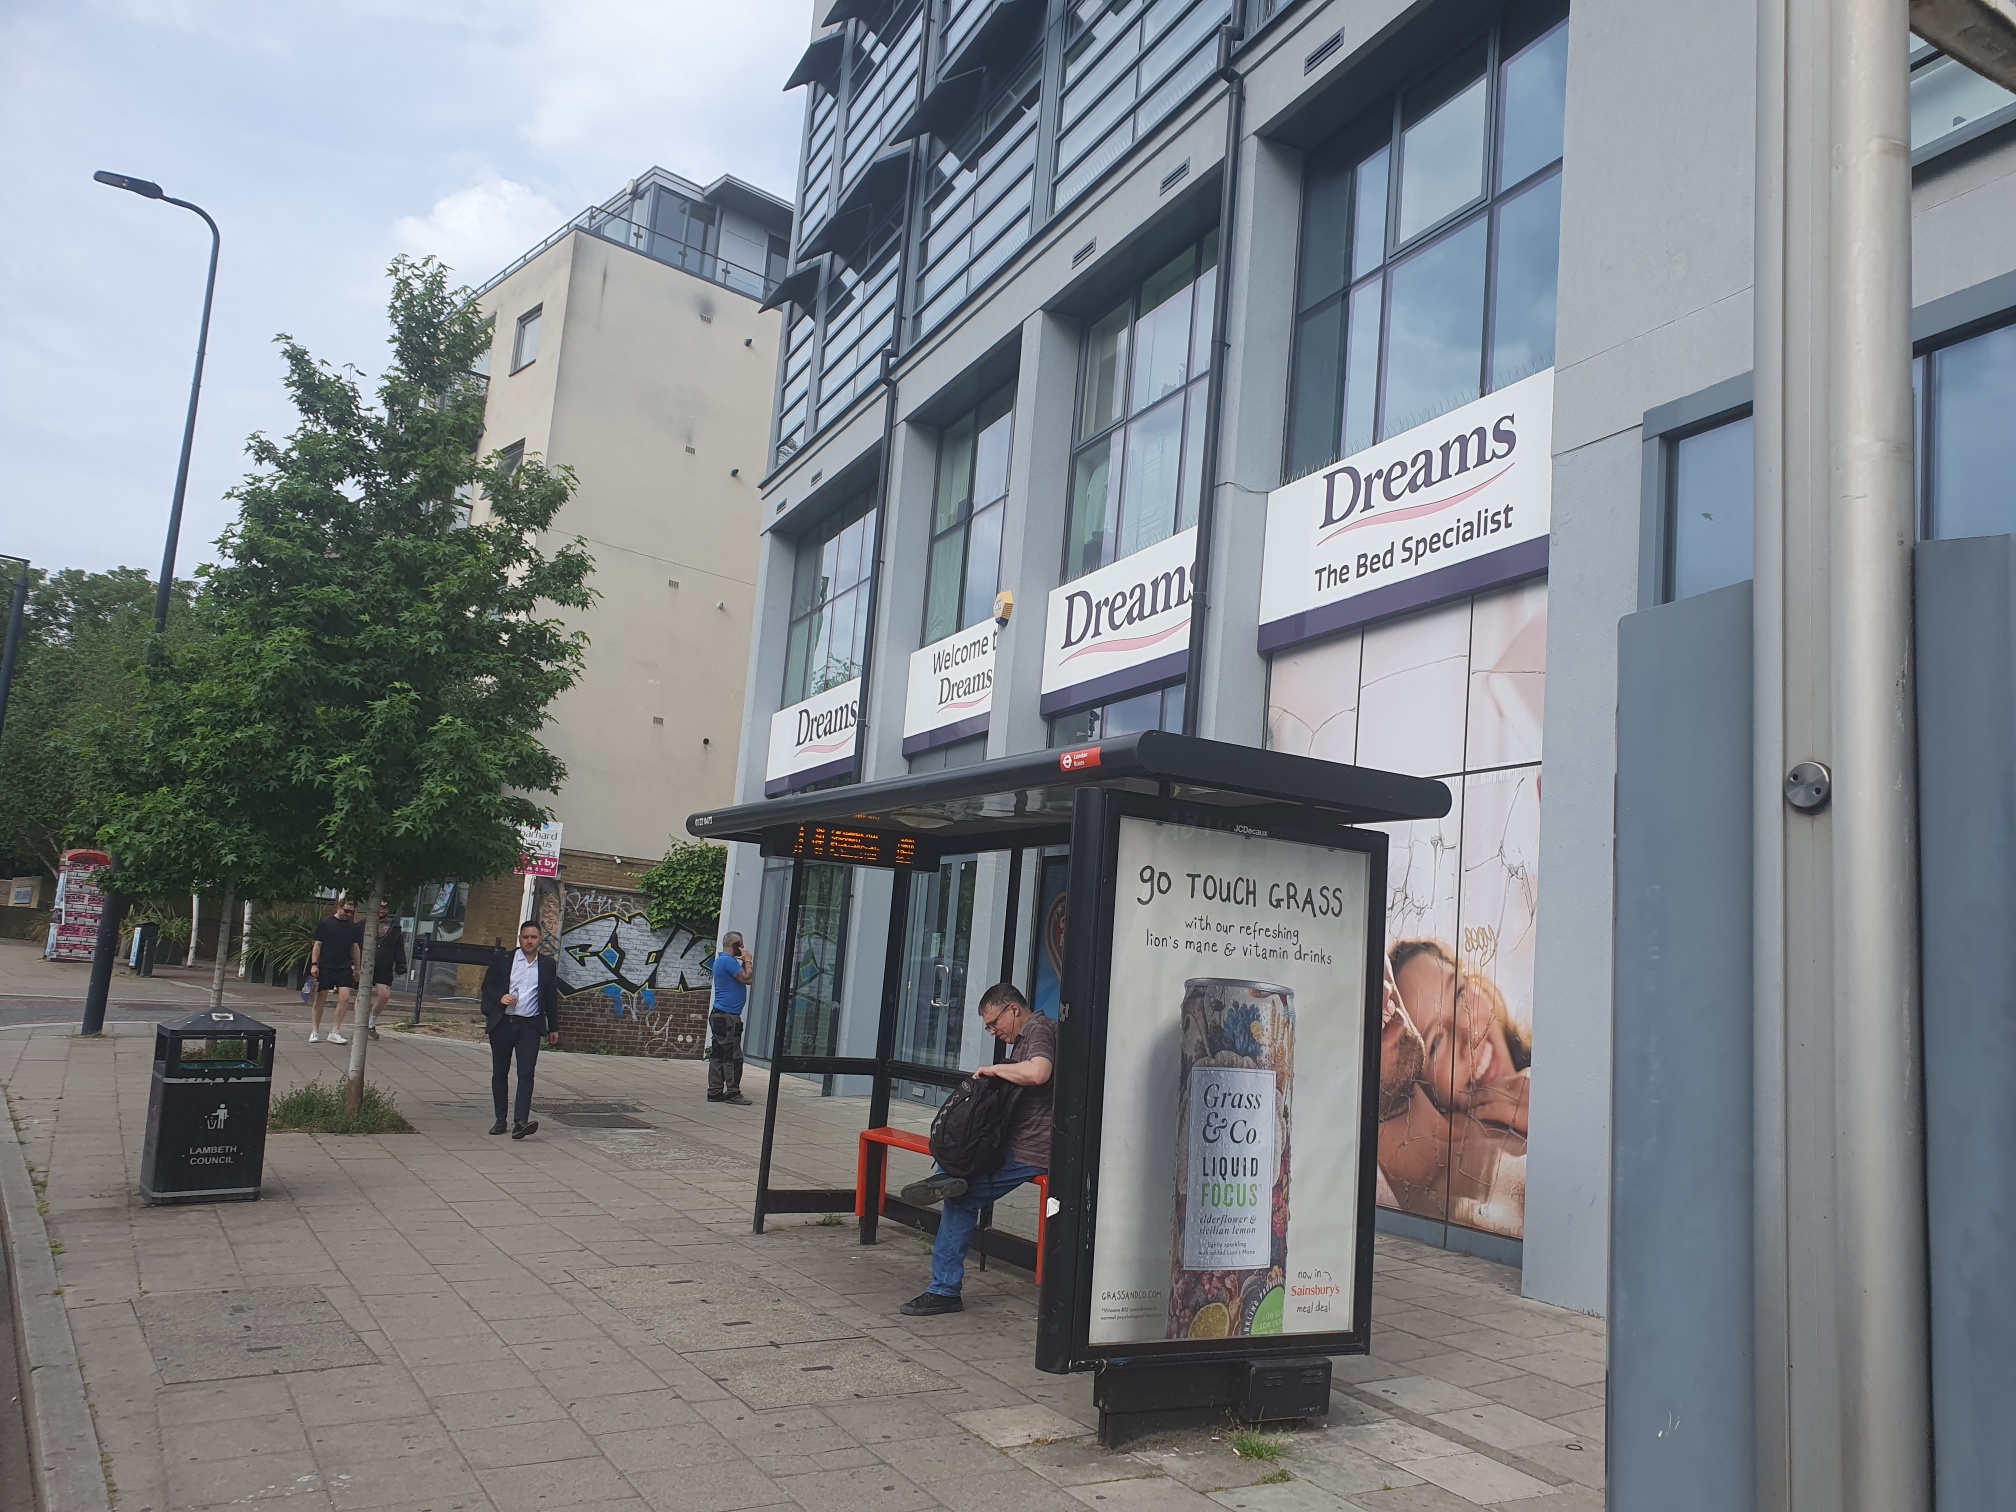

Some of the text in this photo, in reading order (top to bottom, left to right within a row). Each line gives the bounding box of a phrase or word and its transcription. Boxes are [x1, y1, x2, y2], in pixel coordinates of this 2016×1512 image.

[1319, 413, 1517, 530] Dreams
[1314, 503, 1514, 592] The Bed Specialist
[933, 635, 989, 675] Welcome
[937, 668, 993, 706] Dreams
[794, 699, 858, 748] Dreams
[1233, 824, 1269, 837] JCDecaux
[544, 858, 557, 869] by
[1137, 864, 1343, 918] go TOUCH GRASS
[1185, 914, 1300, 946] with our refreshing
[1146, 928, 1333, 966] lion's mane & vitamin drinks
[1203, 1083, 1262, 1110] Grass
[189, 1145, 238, 1155] LAMBETH
[189, 1156, 235, 1165] COUNCIL
[1202, 1156, 1259, 1181] LIQUID
[1199, 1214, 1257, 1227] elderflower &
[1199, 1225, 1256, 1235] sicilian lemon
[1297, 1268, 1322, 1280] now in
[1101, 1290, 1162, 1301] GRASSANDCO.COM
[1290, 1283, 1341, 1297] Sainsbury's
[1296, 1300, 1331, 1314] meal deal
